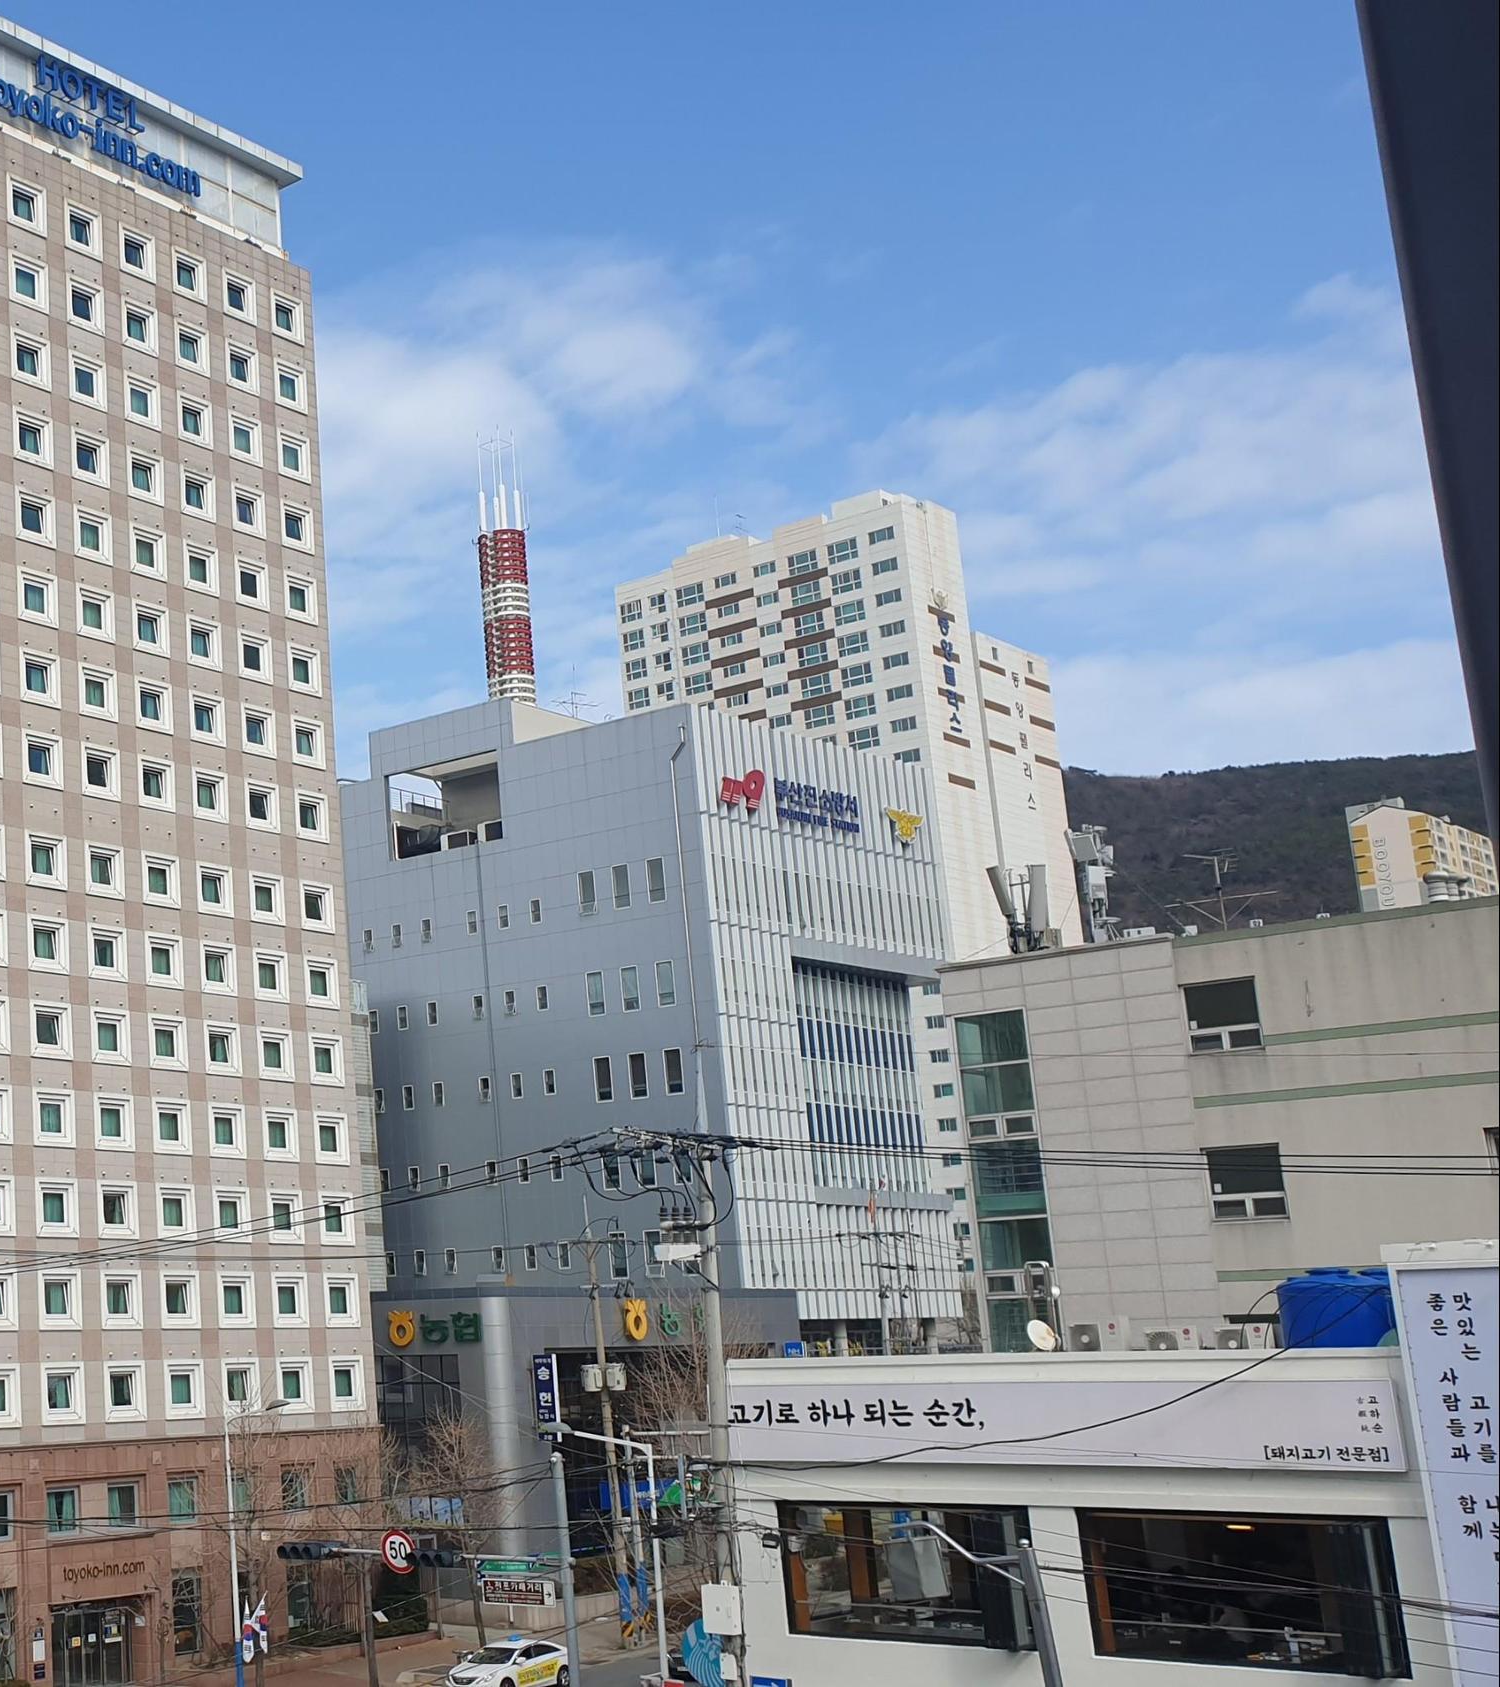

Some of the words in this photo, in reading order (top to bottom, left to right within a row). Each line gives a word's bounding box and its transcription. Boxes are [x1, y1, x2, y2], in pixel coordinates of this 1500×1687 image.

[35, 54, 145, 134] HOTEL
[774, 776, 859, 818] 부산진소방서
[419, 1311, 482, 1343] 농협
[1452, 1291, 1481, 1361] 맛있는
[1469, 1395, 1498, 1463] 고기를
[728, 1398, 800, 1427] 고기로
[807, 1398, 855, 1428] 하나
[863, 1398, 914, 1428] 되는
[923, 1397, 985, 1431] 순간,
[1367, 1395, 1383, 1434] 고하순
[1426, 1292, 1449, 1336] 좋은
[1439, 1367, 1471, 1462] 사람들과
[1457, 1494, 1483, 1540] 함께
[1263, 1445, 1331, 1461] [돼지고기
[1336, 1446, 1390, 1462] 전문점]
[389, 1540, 408, 1560] 50
[62, 1561, 146, 1585] toyoko-inn.com
